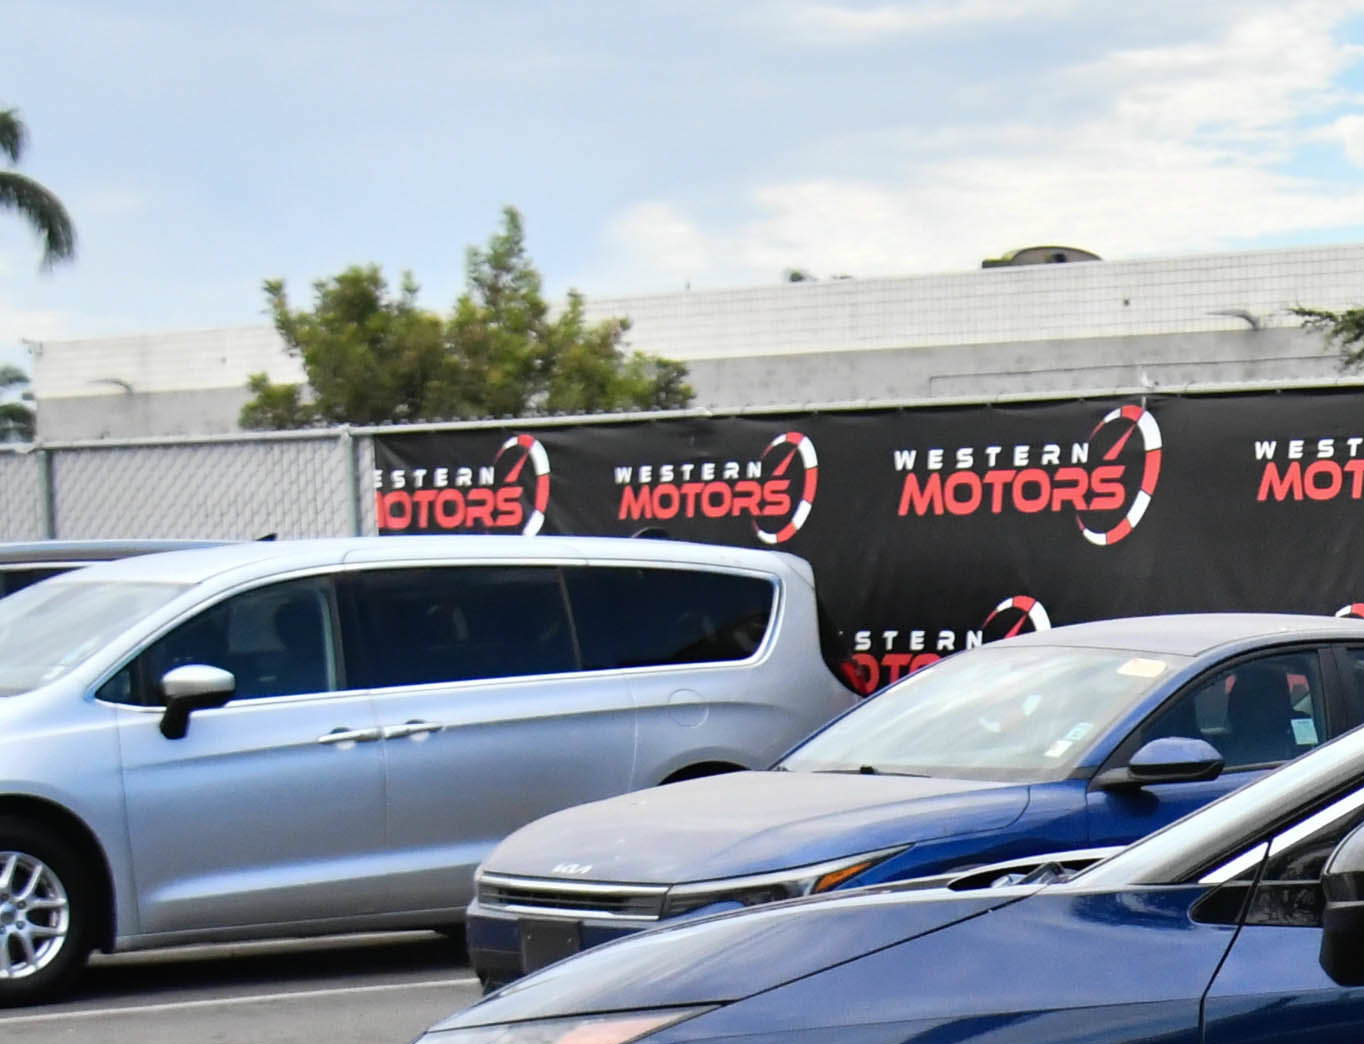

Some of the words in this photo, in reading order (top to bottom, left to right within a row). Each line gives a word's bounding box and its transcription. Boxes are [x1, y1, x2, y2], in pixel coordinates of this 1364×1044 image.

[894, 442, 1089, 471] WESTERN
[614, 461, 762, 484] WESTERN
[618, 479, 792, 521] MOTORS
[897, 464, 1127, 517] MOTORS
[855, 630, 984, 652] STERN
